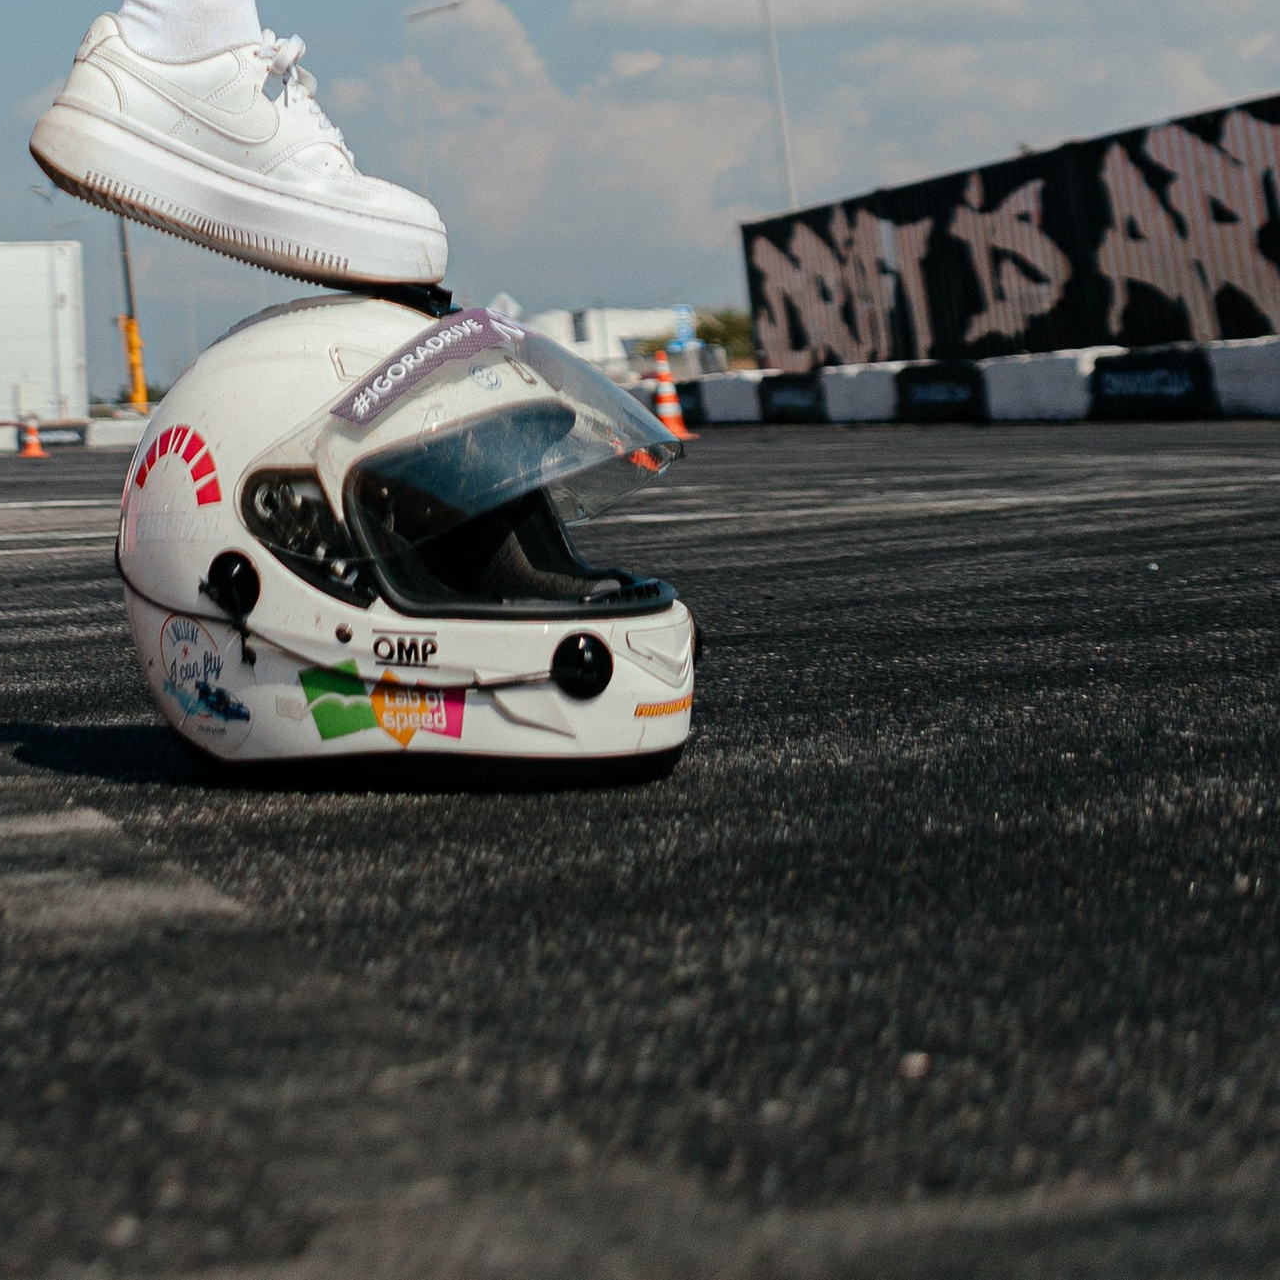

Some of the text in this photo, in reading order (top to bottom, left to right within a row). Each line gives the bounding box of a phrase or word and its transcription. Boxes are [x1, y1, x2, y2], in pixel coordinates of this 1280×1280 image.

[353, 318, 484, 418] #IGORADRIVE
[373, 636, 438, 666] OMP
[382, 706, 447, 734] speed
